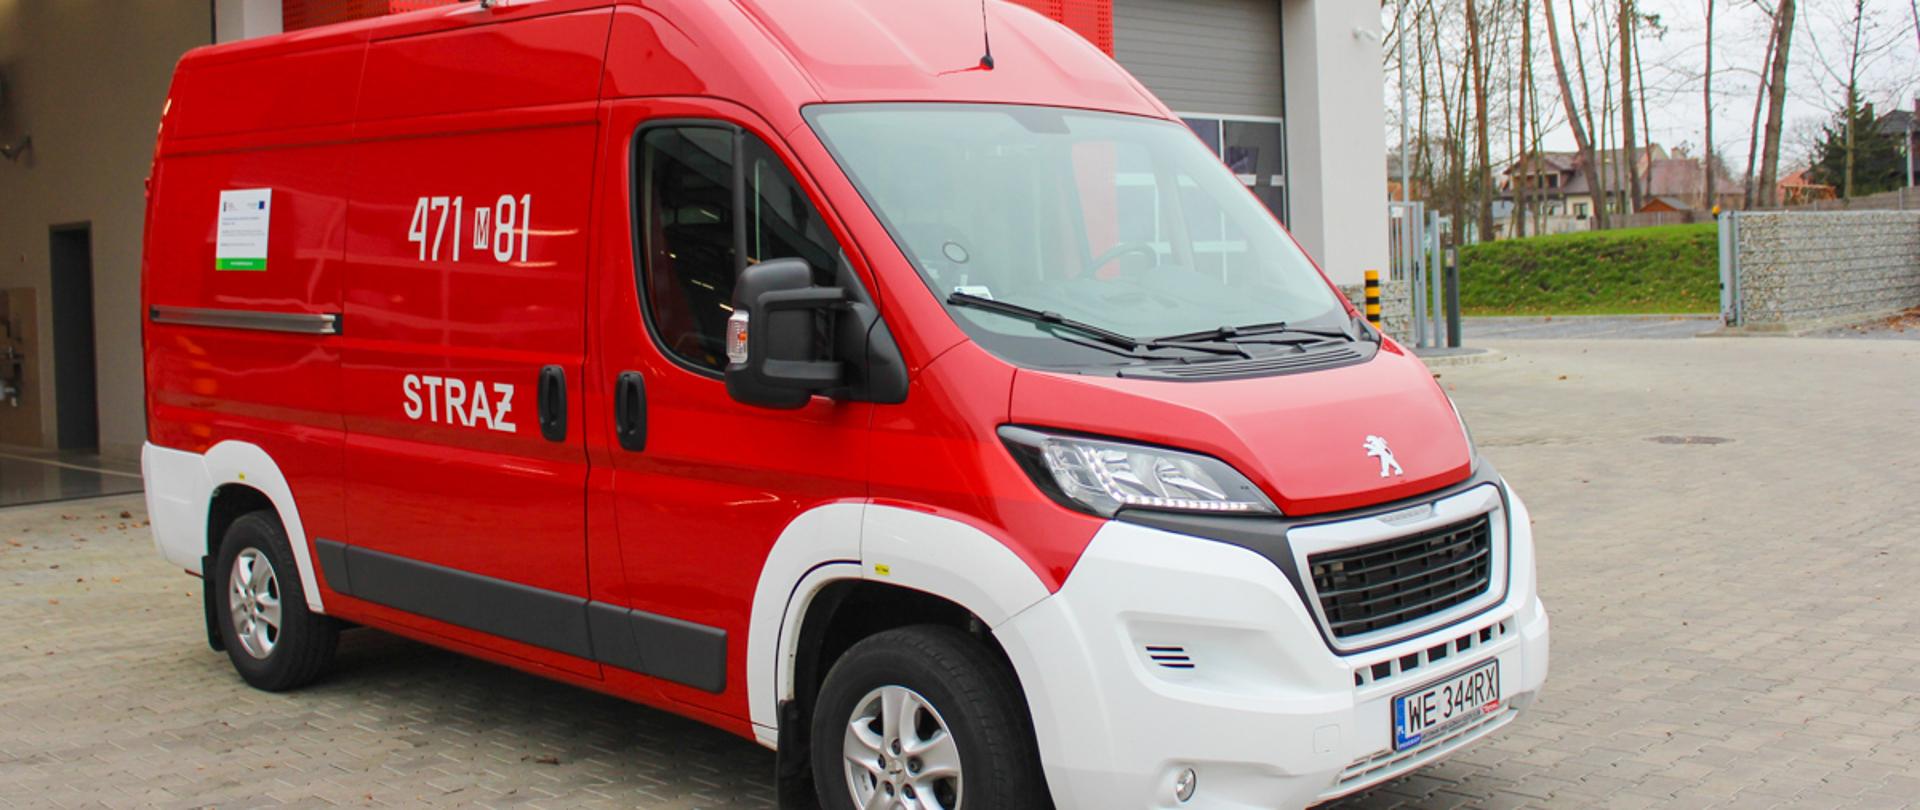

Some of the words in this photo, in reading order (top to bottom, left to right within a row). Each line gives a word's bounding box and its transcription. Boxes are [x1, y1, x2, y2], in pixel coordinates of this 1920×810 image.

[408, 196, 463, 262] 471
[474, 207, 490, 250] M
[494, 194, 531, 263] 81
[1408, 691, 1436, 733] WE
[1443, 666, 1495, 718] 344RX
